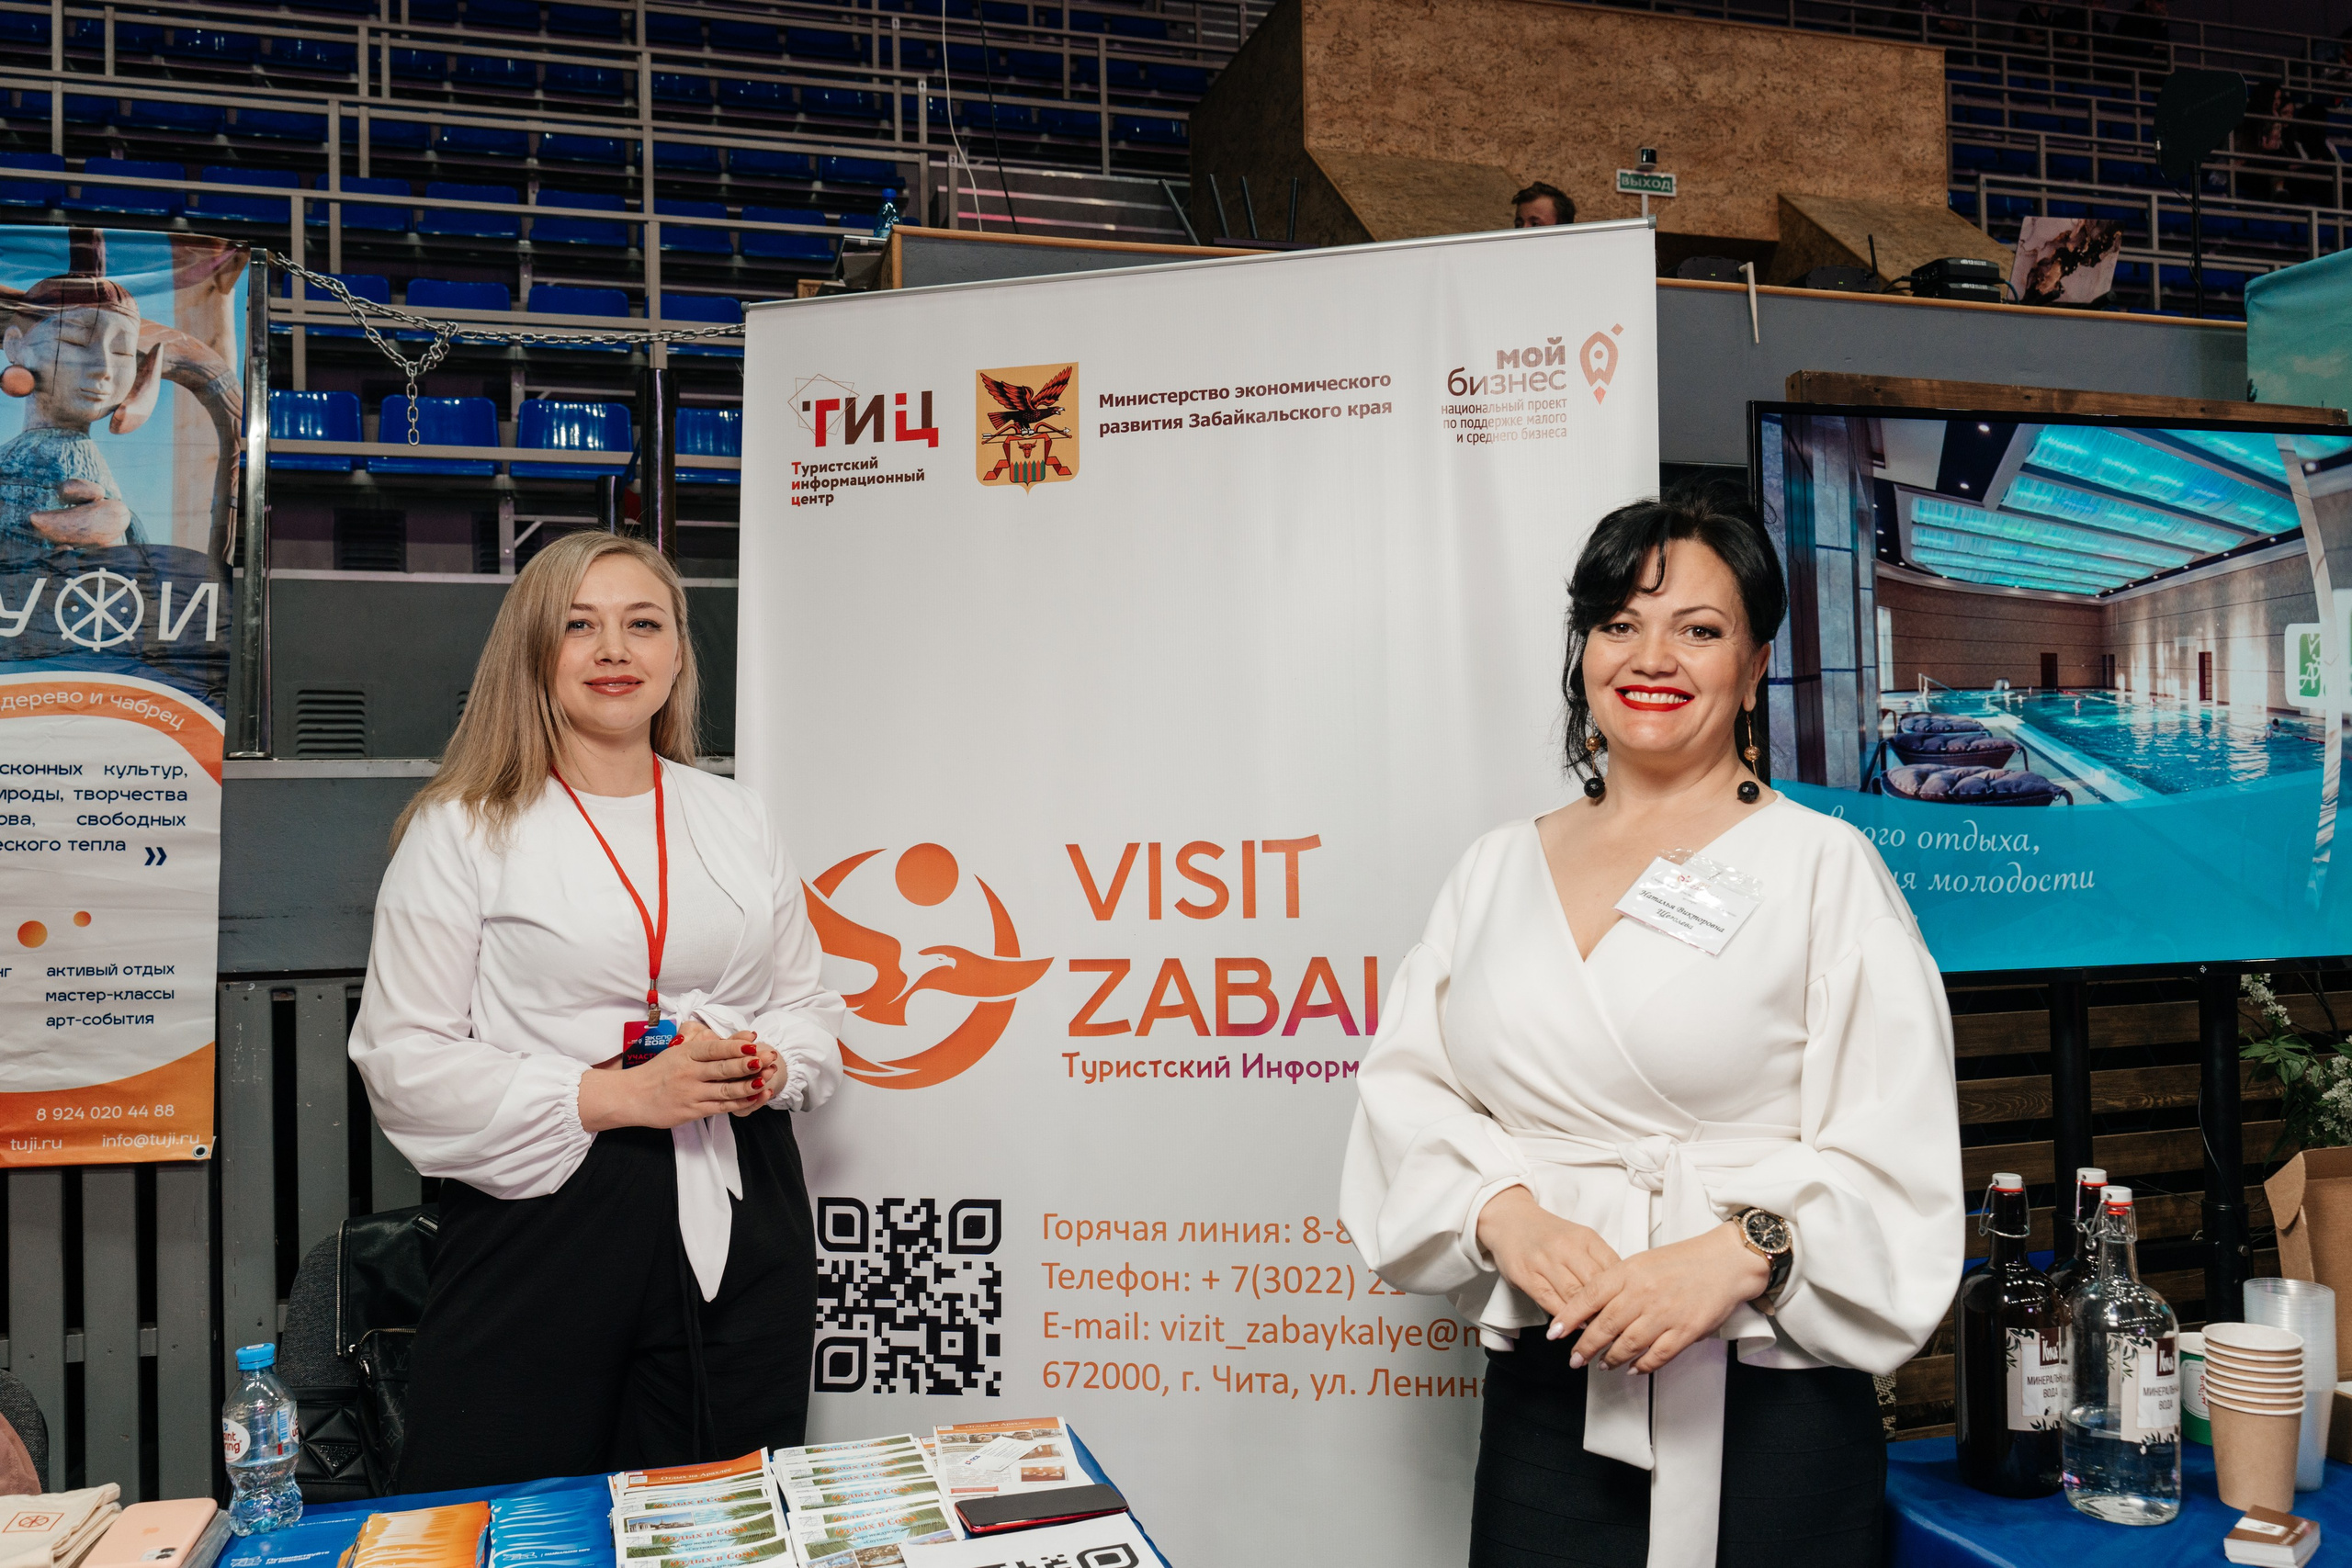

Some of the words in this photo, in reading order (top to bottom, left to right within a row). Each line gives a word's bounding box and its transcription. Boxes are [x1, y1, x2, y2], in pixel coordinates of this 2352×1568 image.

[1621, 176, 1671, 191] ВЫХОД
[1496, 336, 1566, 370] мой
[1099, 387, 1230, 409] Министерство
[1235, 374, 1391, 399] экономического
[1447, 367, 1567, 397] бизнес
[1442, 399, 1524, 416] национальный
[1527, 398, 1567, 413] проект
[1099, 415, 1183, 438] развития
[1189, 401, 1342, 428] Забайкальского
[1347, 400, 1393, 419] края
[1442, 417, 1457, 429] по
[1460, 415, 1523, 430] поддержке
[1526, 412, 1567, 425] малого
[1456, 433, 1464, 443] и
[1466, 430, 1518, 446] среднего
[1521, 427, 1567, 440] бизнеса
[791, 457, 878, 480] Туристский
[791, 469, 925, 491] информационный
[791, 493, 834, 506] центр
[1, 692, 83, 711] дерево
[89, 693, 103, 705] и
[109, 694, 185, 731] чабрец
[104, 765, 187, 780] культур,
[74, 789, 187, 804] творчества
[76, 812, 187, 828] свободных
[68, 840, 126, 851] тепла
[1917, 819, 2040, 855] отдыха,
[1065, 834, 1322, 921] VISIT
[1928, 862, 2096, 893] молодости
[1639, 889, 1676, 909] Наталья
[1677, 907, 1725, 933] Викторовна
[123, 965, 175, 976] отдых
[46, 989, 175, 1003] мастер-классы
[47, 1013, 154, 1029] арт-события
[1061, 1051, 1230, 1085] Туристский
[1242, 1053, 1360, 1085] Информ
[36, 1108, 47, 1121] 8
[52, 1107, 85, 1121] 924
[90, 1106, 122, 1119] 020
[128, 1106, 149, 1117] 44
[153, 1104, 175, 1117] 88
[10, 1137, 62, 1153] tuji.ru
[102, 1133, 200, 1148] info@tuji.ru
[1043, 1213, 1168, 1247] Горячая
[1178, 1221, 1291, 1245] линия:
[1041, 1262, 1191, 1298] Телефон:
[1231, 1263, 1356, 1301] 7(3022)
[1044, 1311, 1150, 1342] E-mail:
[1043, 1361, 1169, 1397] 672000,
[1182, 1370, 1200, 1393] г.
[1212, 1364, 1299, 1399] Чита,
[1310, 1373, 1357, 1402] ул.
[1367, 1368, 1486, 1398] Ленин
[662, 1532, 703, 1544] Отдых
[717, 1526, 748, 1536] Сочи
[835, 1524, 876, 1537] Отдых
[888, 1516, 918, 1527] Сочи
